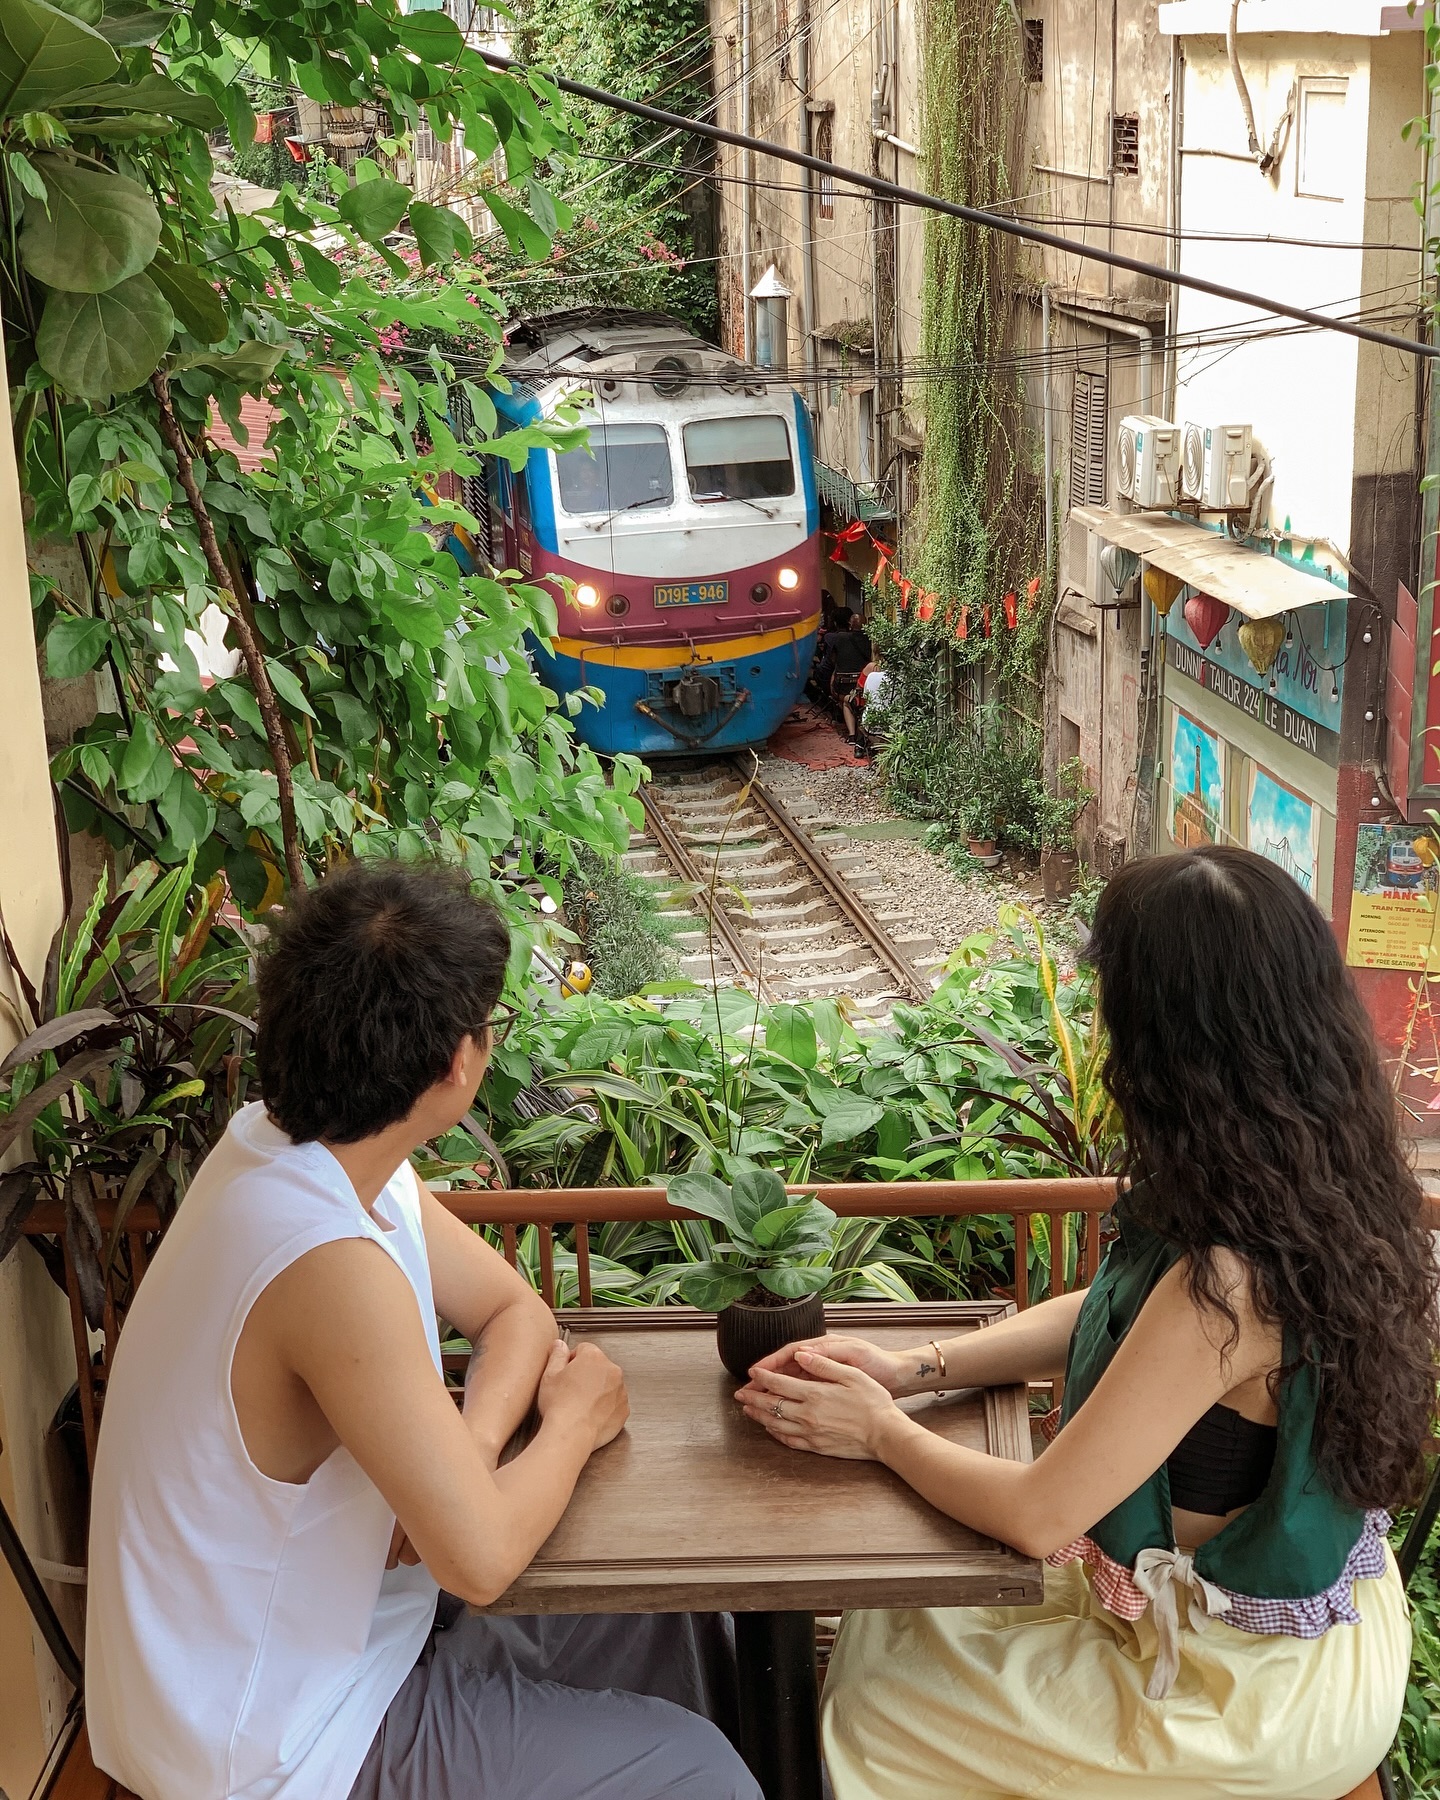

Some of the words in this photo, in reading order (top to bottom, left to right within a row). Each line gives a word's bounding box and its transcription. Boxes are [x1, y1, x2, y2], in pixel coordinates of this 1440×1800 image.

[1209, 664, 1241, 706] TAILOR
[1243, 684, 1260, 719] 224
[1264, 698, 1278, 729] LE
[1284, 709, 1318, 753] DUAN
